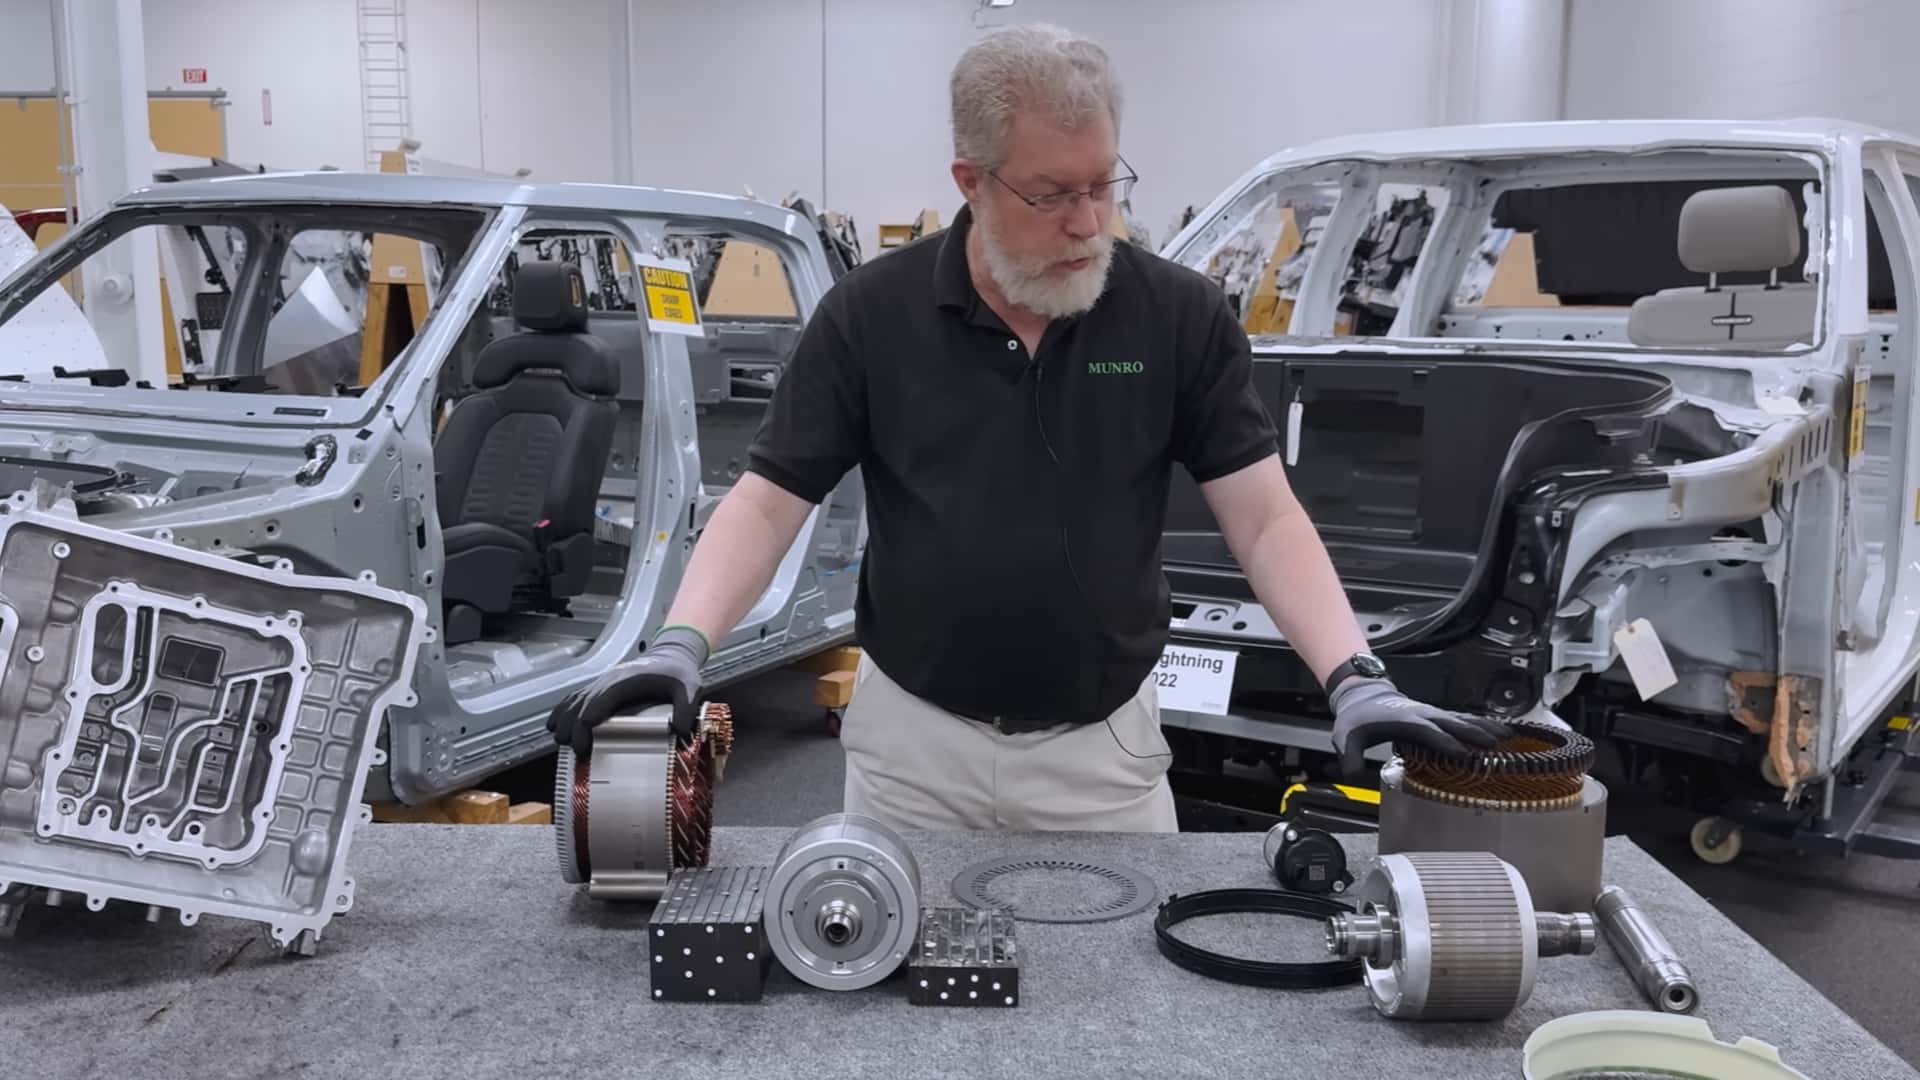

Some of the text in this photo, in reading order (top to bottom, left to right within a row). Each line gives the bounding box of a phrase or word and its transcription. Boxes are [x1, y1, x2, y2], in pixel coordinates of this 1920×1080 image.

[643, 267, 689, 289] CAUTION
[1088, 361, 1144, 374] MUNRO
[1159, 651, 1223, 673] ghtning
[1152, 671, 1178, 687] 022
